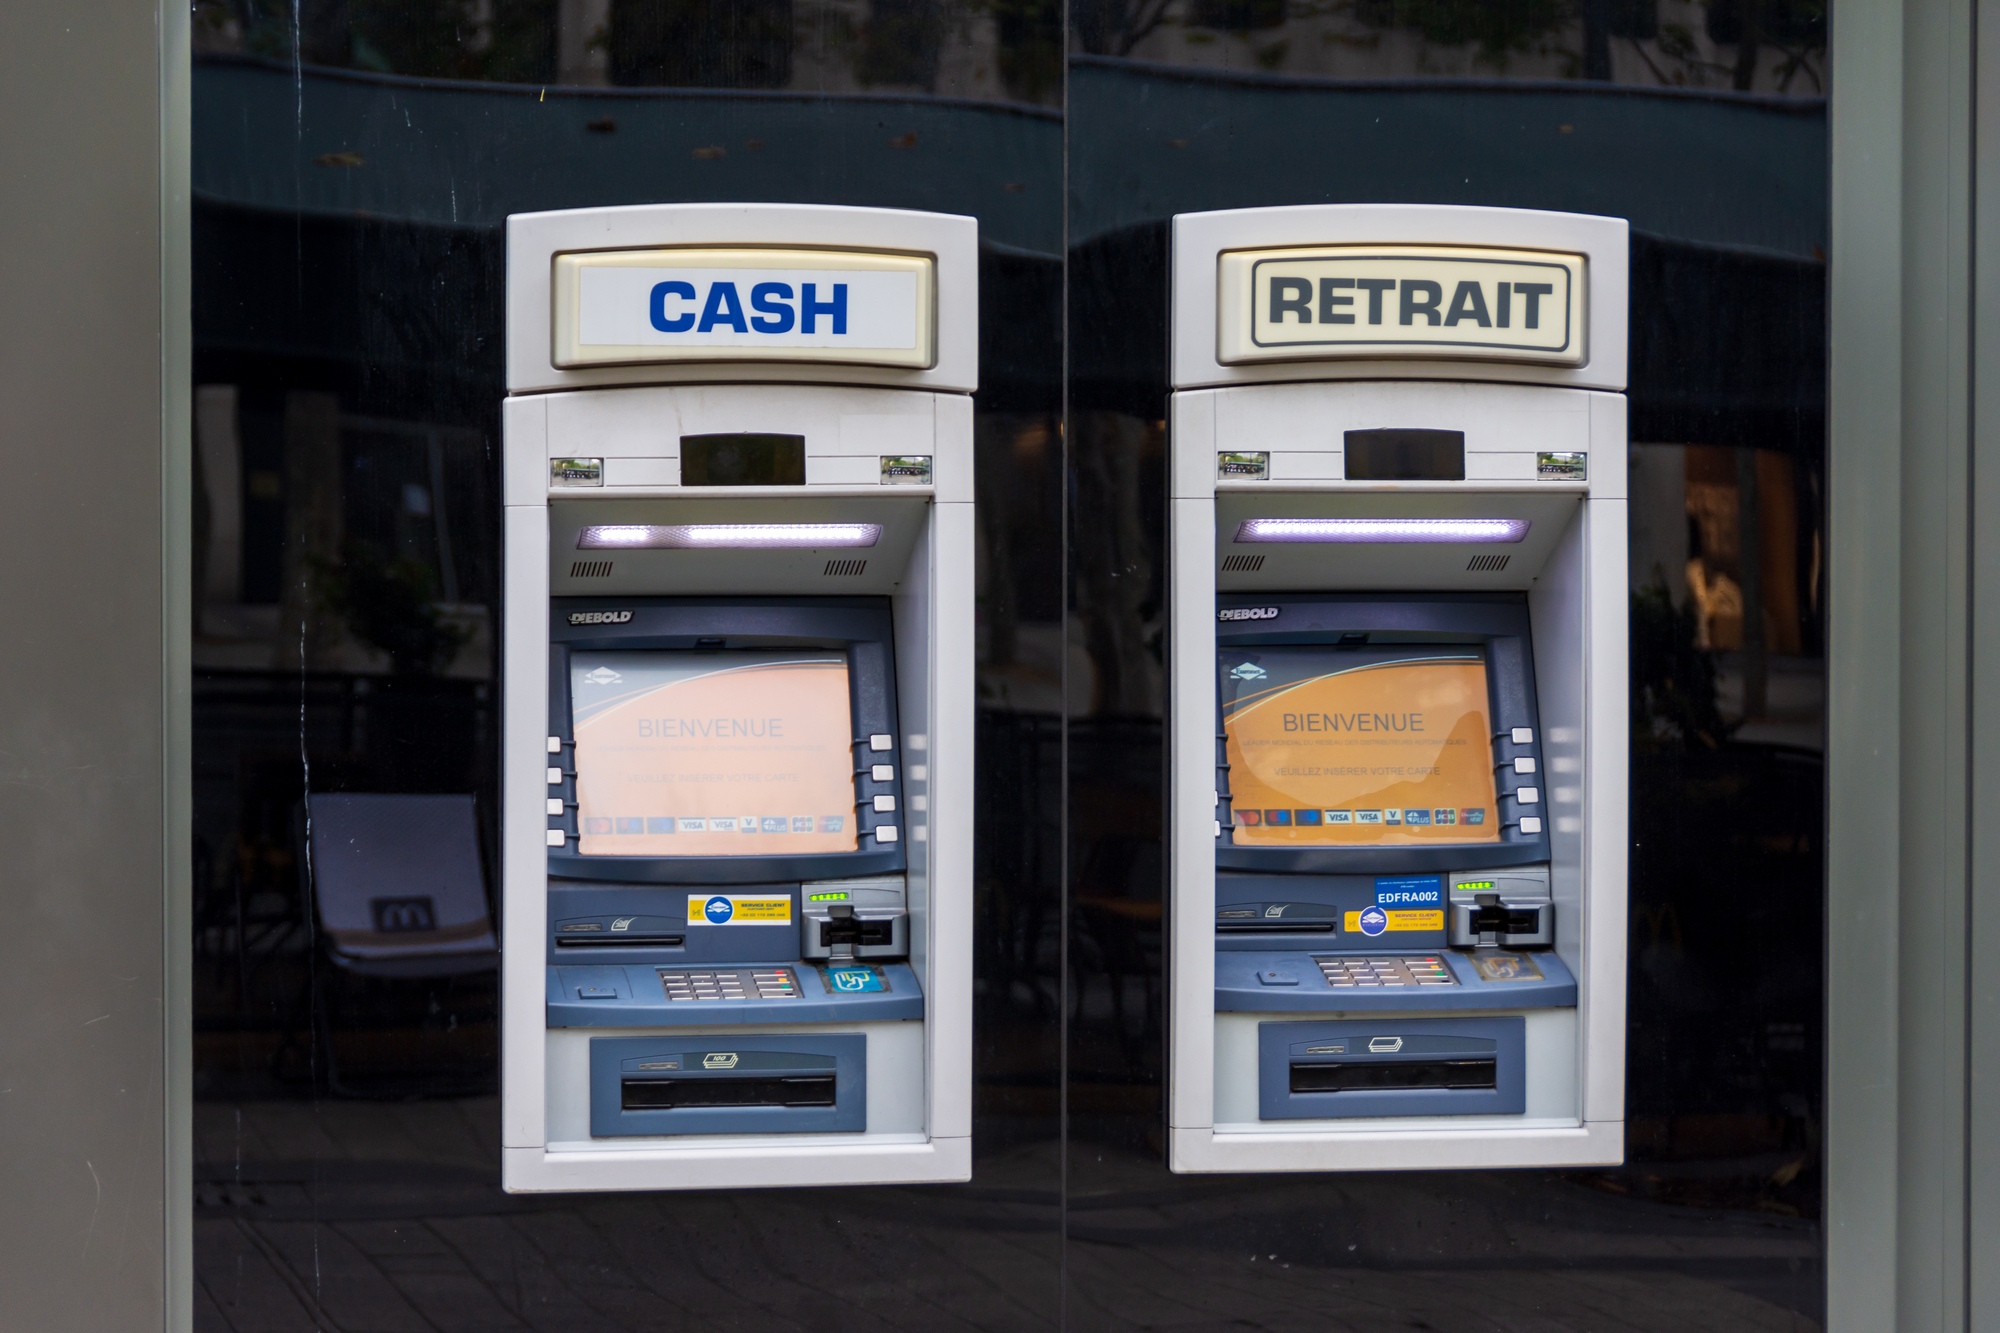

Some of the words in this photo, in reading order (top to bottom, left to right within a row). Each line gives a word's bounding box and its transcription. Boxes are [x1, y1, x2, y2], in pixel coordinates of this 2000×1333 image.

[649, 280, 848, 335] CASH
[1269, 276, 1553, 330] RETRAIT
[569, 610, 632, 625] DIEBOLD
[1218, 607, 1279, 621] DIEBOLD
[638, 718, 784, 738] BIENVENUE
[1283, 713, 1425, 732] BIENVENUE
[1273, 767, 1322, 776] VEUILLEZ
[1323, 765, 1367, 776] INSÉRER
[1370, 766, 1404, 776] VOTRE
[1406, 766, 1441, 776] CARTE
[627, 774, 676, 783] VEUILLEZ
[726, 773, 762, 782] VOTRE
[764, 773, 799, 782] CARTE
[1328, 813, 1349, 822] VISA
[1389, 811, 1397, 819] V
[681, 821, 704, 829] VISA
[713, 820, 734, 828] VISA
[745, 818, 753, 826] V
[1378, 891, 1438, 903] EDFRA002
